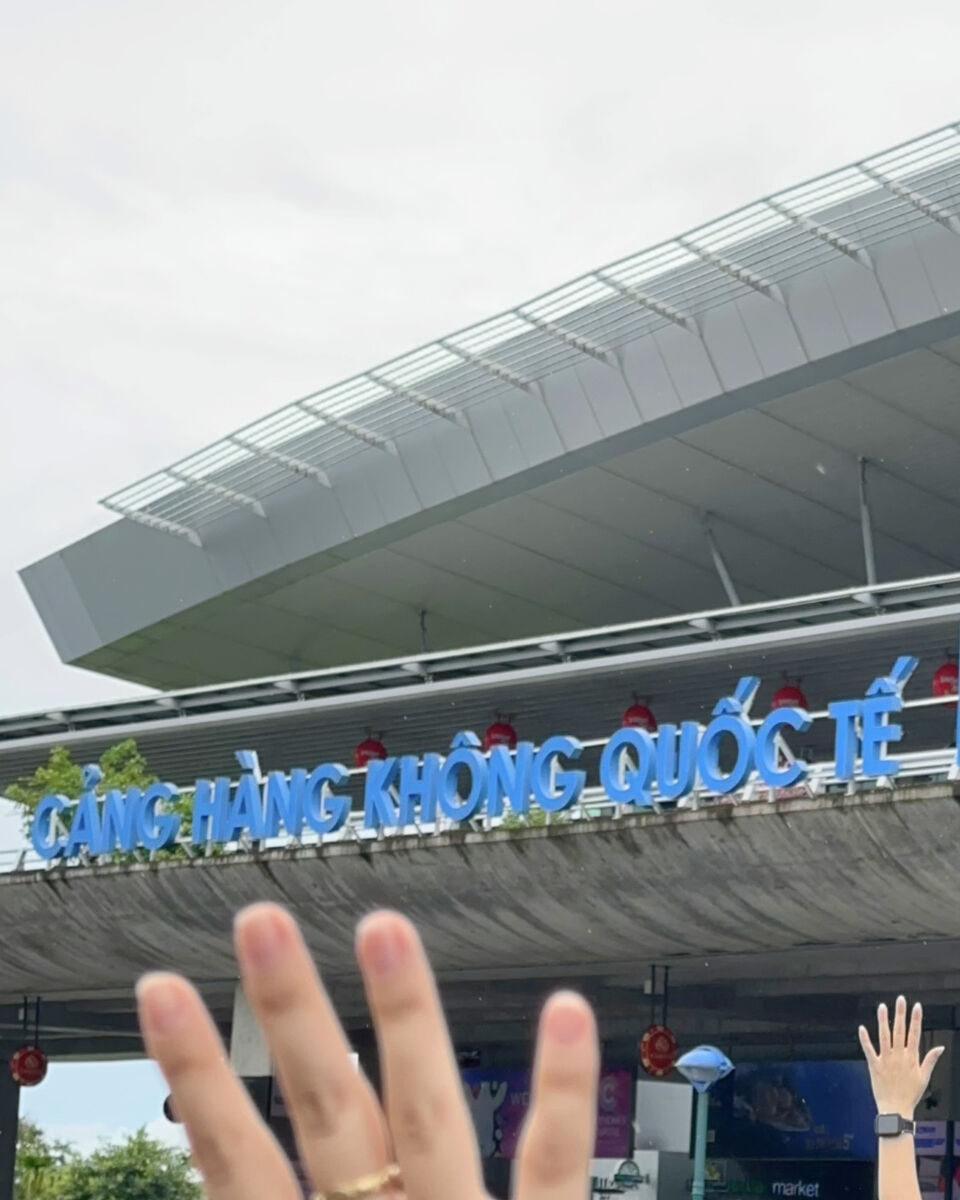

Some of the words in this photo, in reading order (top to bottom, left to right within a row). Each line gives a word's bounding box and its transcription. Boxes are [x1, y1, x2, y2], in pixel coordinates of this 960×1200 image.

[31, 764, 181, 860] CẢNG
[192, 750, 353, 846] HÀNG
[364, 731, 587, 829] KHÔNG
[601, 676, 813, 807] QUỐC
[828, 655, 919, 780] TẾ
[772, 1181, 820, 1198] market
